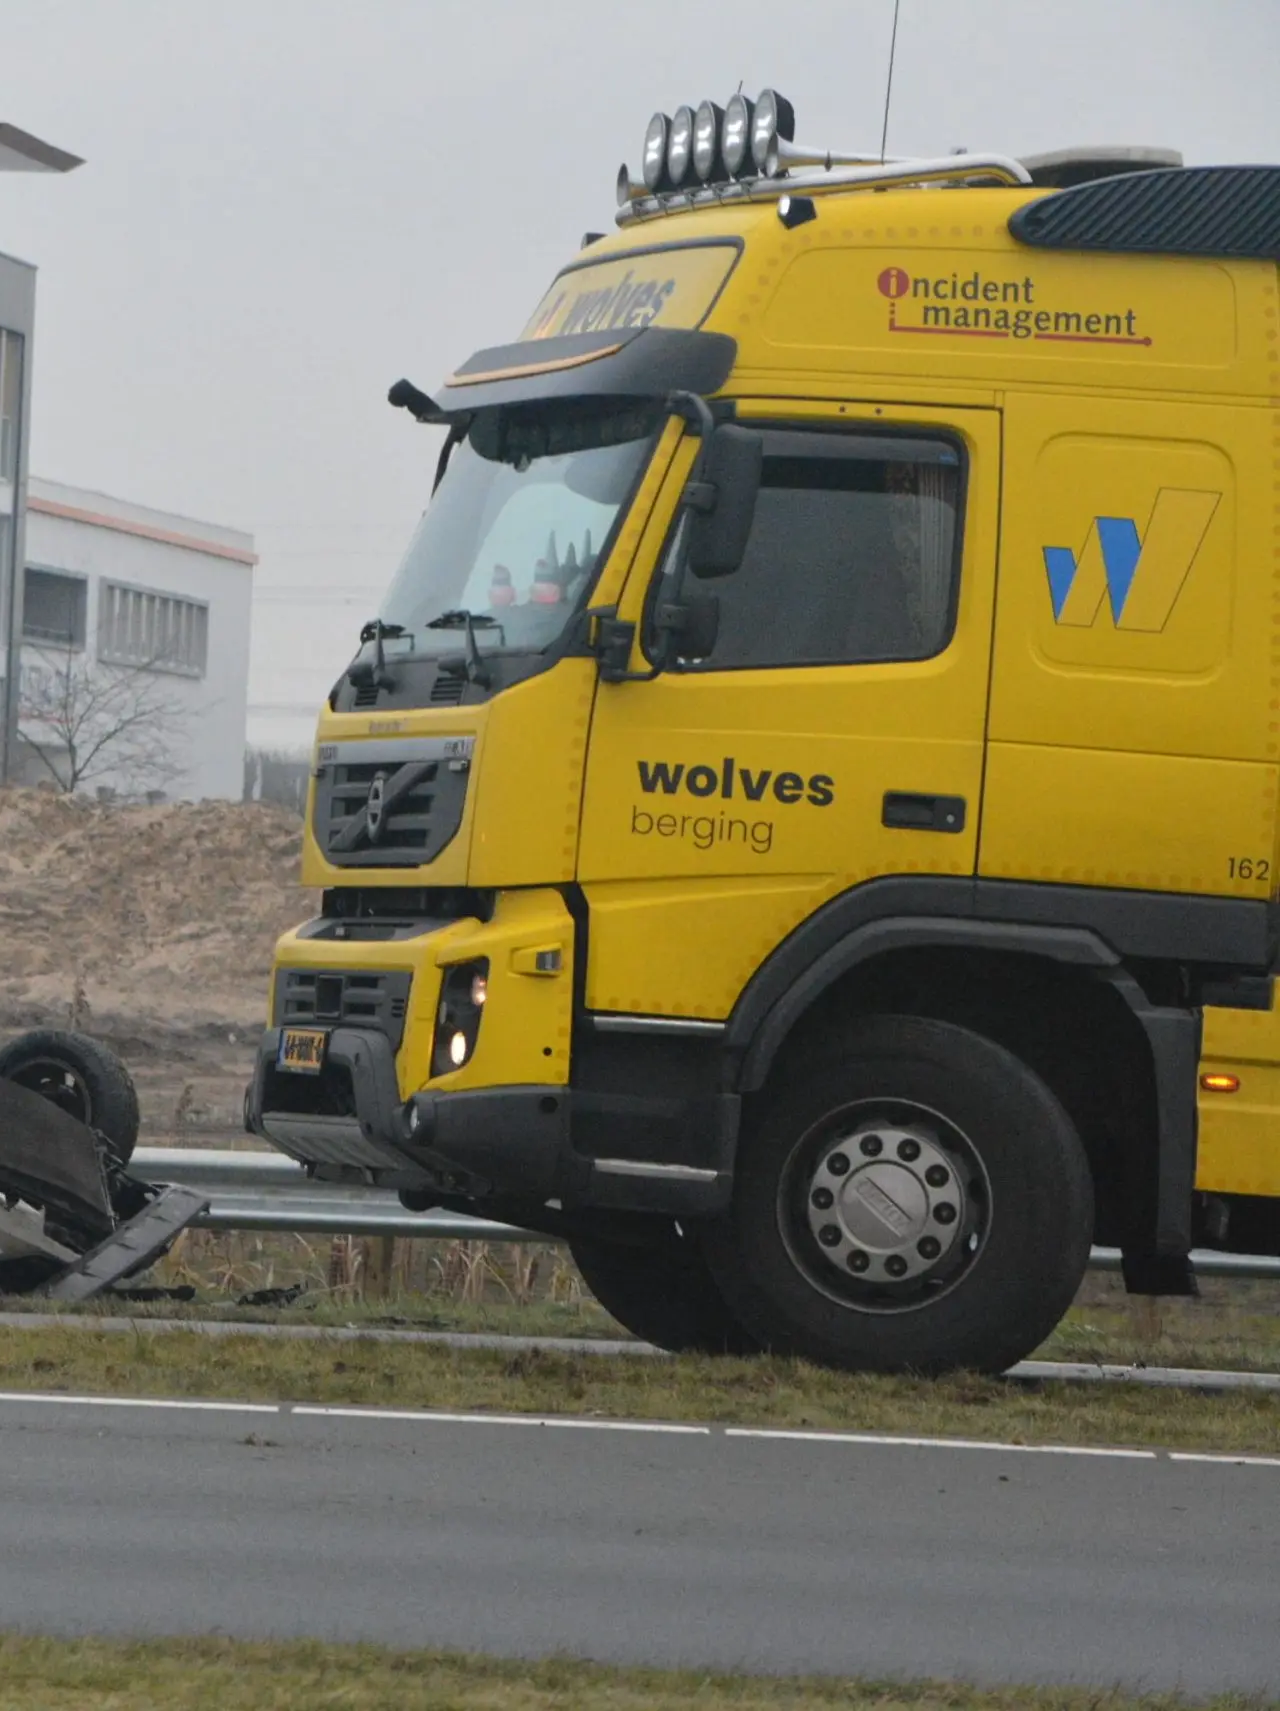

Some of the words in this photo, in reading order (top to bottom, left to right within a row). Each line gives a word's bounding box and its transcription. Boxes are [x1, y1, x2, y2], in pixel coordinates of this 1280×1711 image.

[880, 268, 1034, 303] incident
[922, 304, 1136, 339] management
[637, 757, 835, 806] wolves
[631, 805, 773, 854] berging
[1228, 856, 1269, 881] 162
